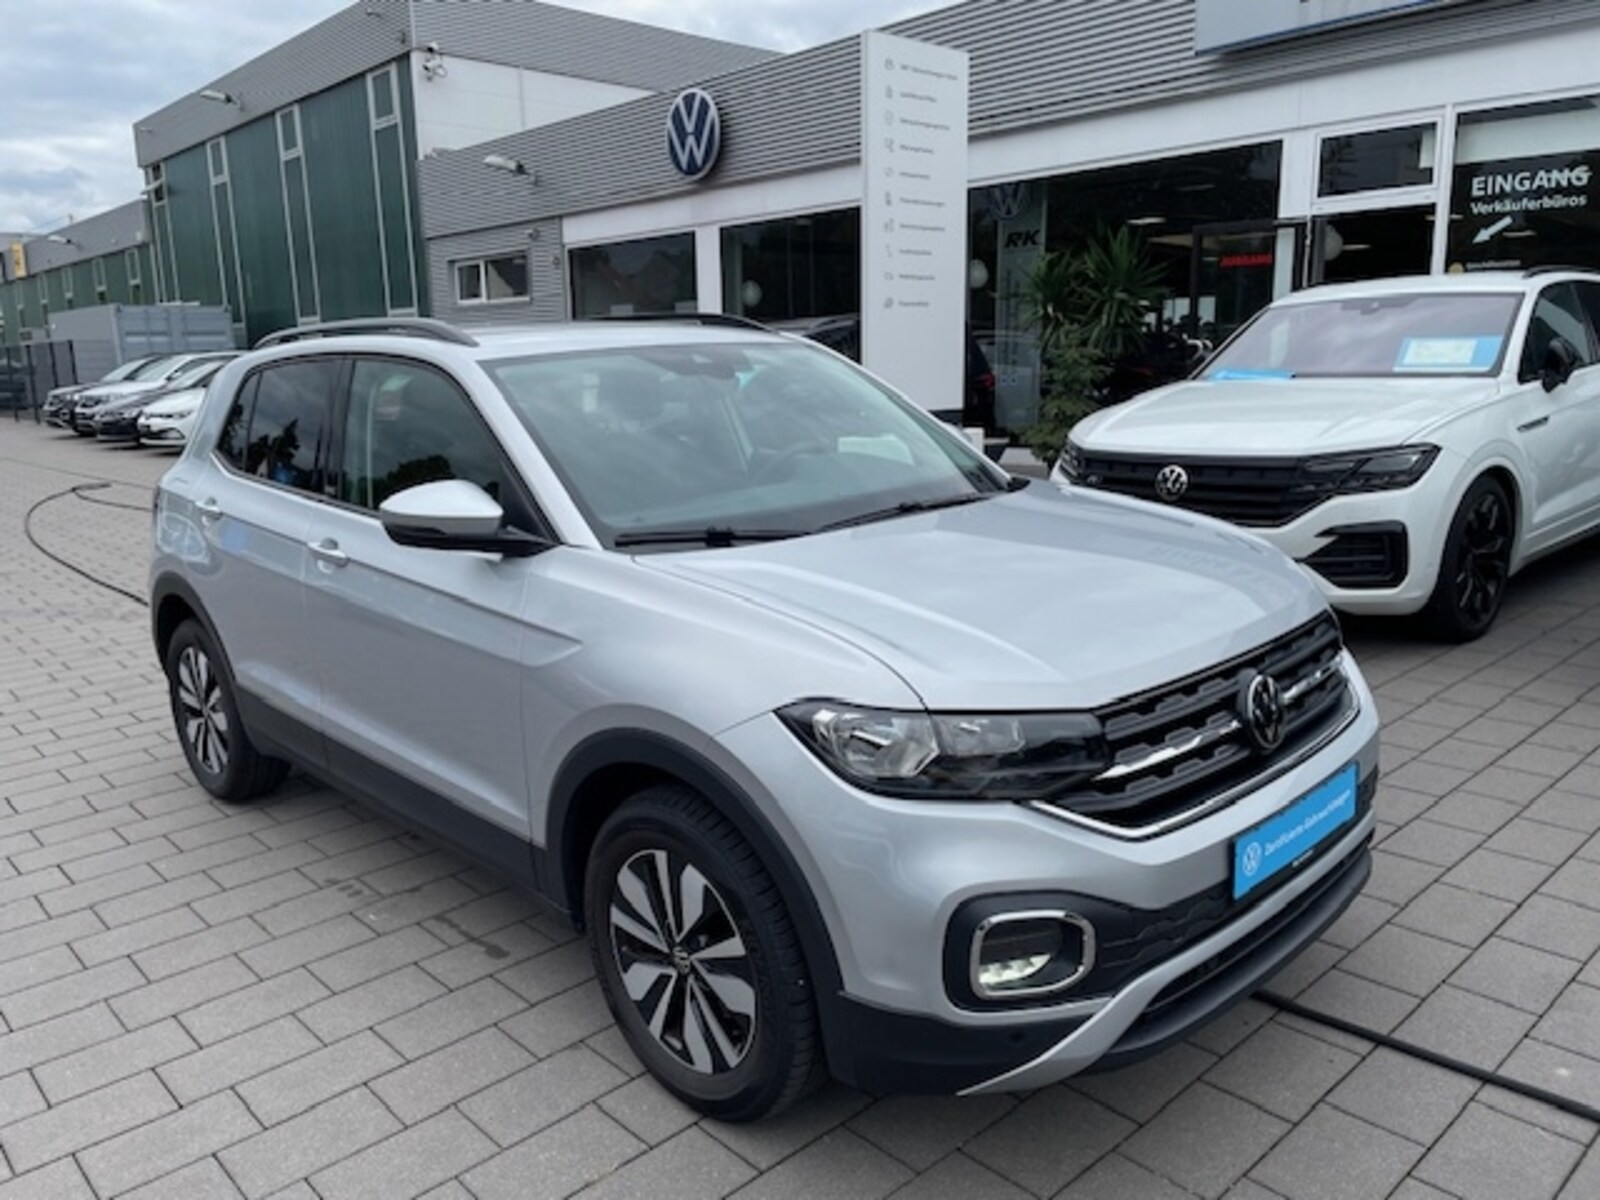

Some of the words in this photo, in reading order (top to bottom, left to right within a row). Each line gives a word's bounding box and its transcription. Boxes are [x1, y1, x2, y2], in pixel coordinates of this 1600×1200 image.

[667, 89, 720, 177] VW
[1471, 166, 1590, 197] EINGANG
[1470, 195, 1588, 214] Verkäuferbüros
[1004, 229, 1041, 248] RK
